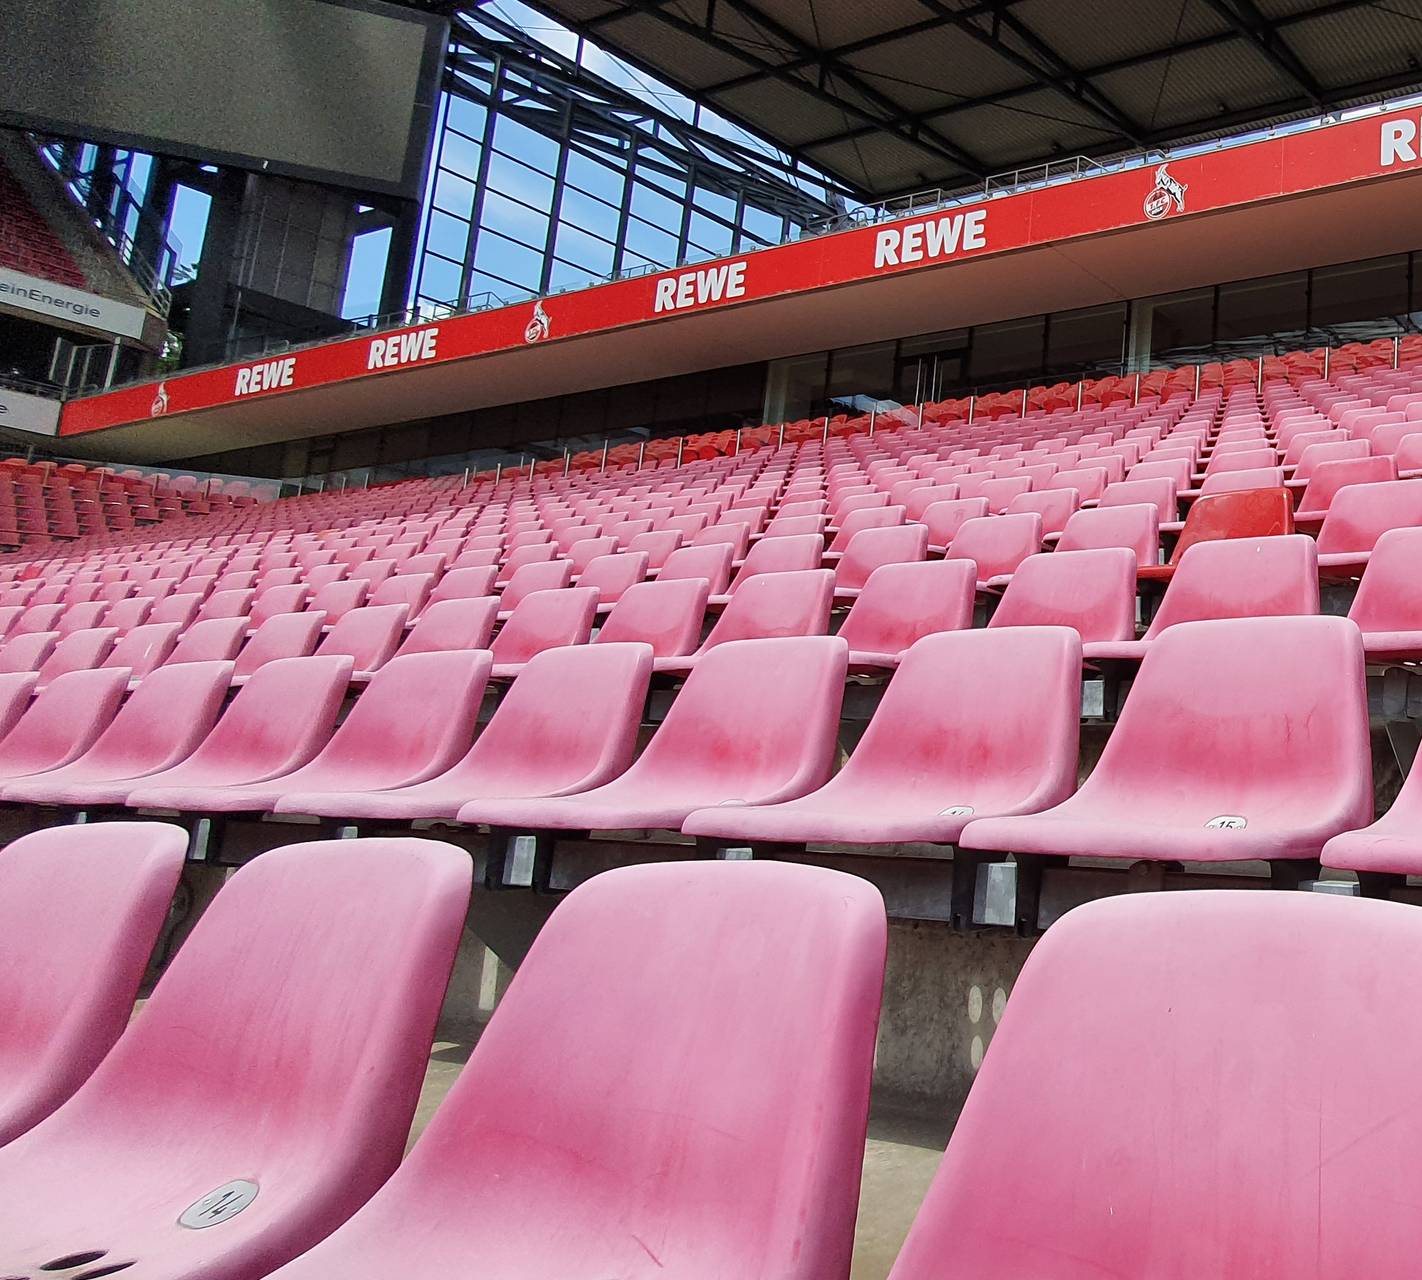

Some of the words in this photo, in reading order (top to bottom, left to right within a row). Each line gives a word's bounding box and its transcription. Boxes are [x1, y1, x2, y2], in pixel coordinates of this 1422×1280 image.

[874, 209, 987, 269] REWE
[654, 262, 747, 312] REWE
[367, 328, 439, 369] REWE
[235, 357, 296, 396] REWE
[197, 1190, 245, 1220] 14
